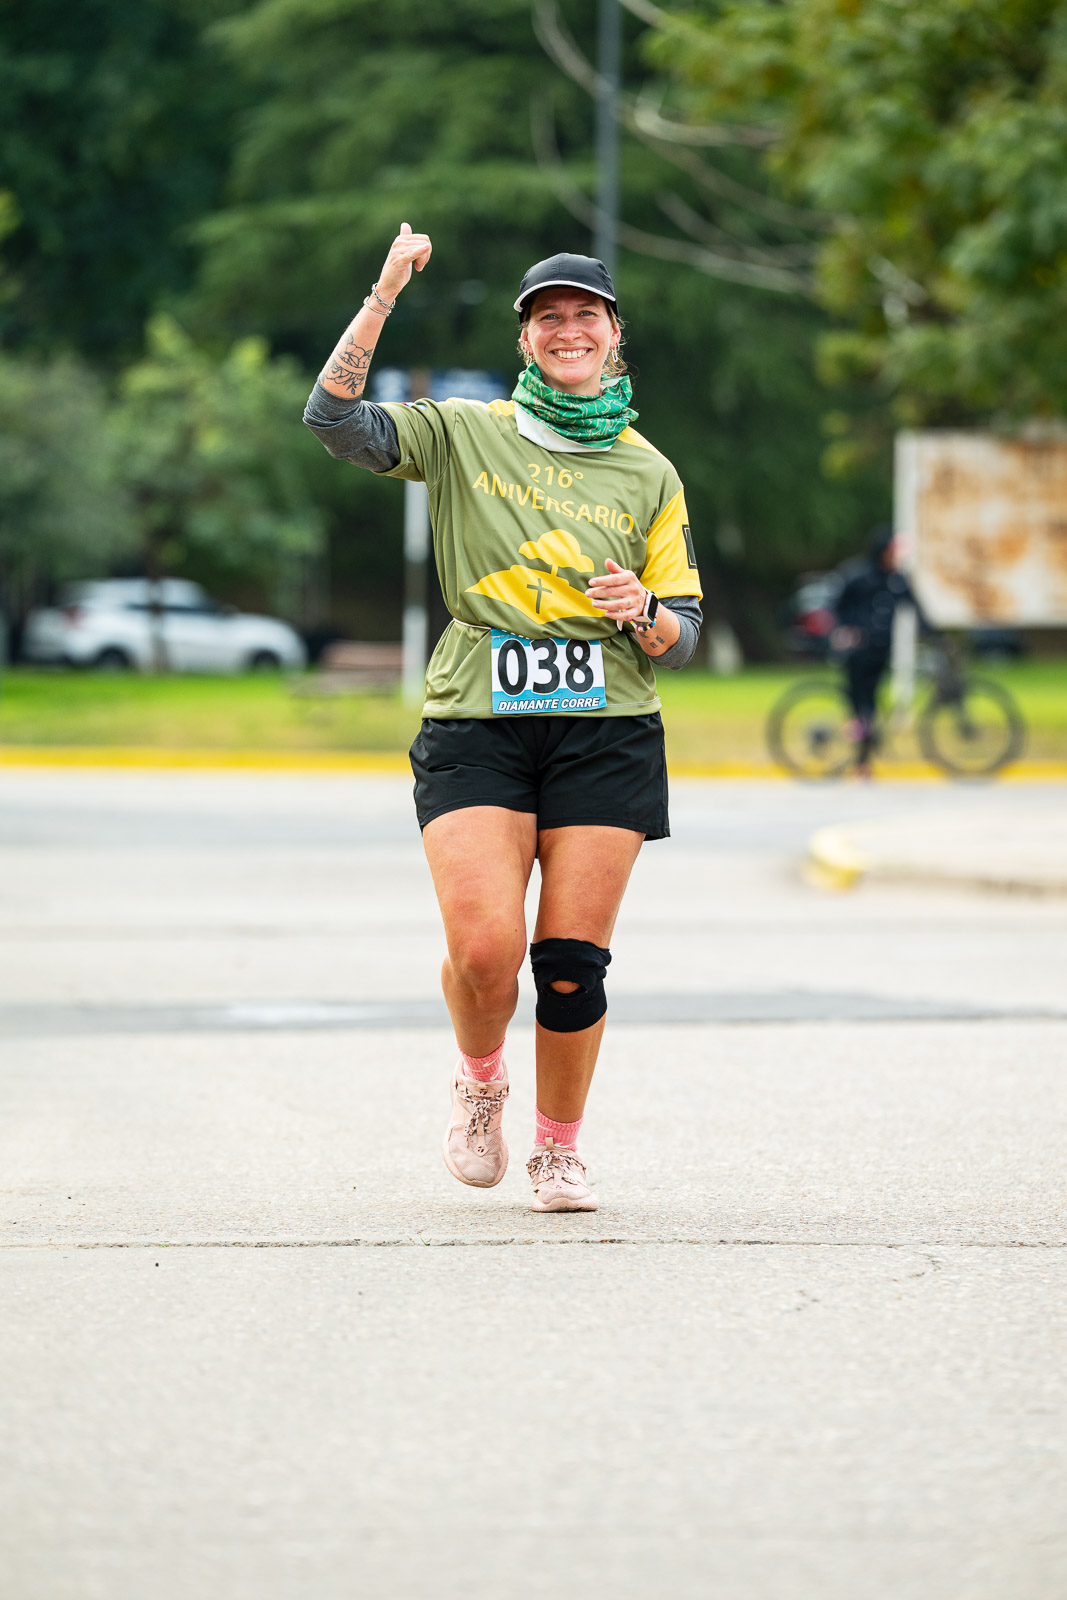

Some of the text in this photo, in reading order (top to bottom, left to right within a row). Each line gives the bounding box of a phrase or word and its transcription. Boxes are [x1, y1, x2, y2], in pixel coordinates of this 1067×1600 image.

[527, 463, 584, 489] 216°
[472, 471, 634, 535] ANIVERSARIO
[497, 639, 594, 696] 038
[498, 697, 600, 711] DIAMANTE CORRE
